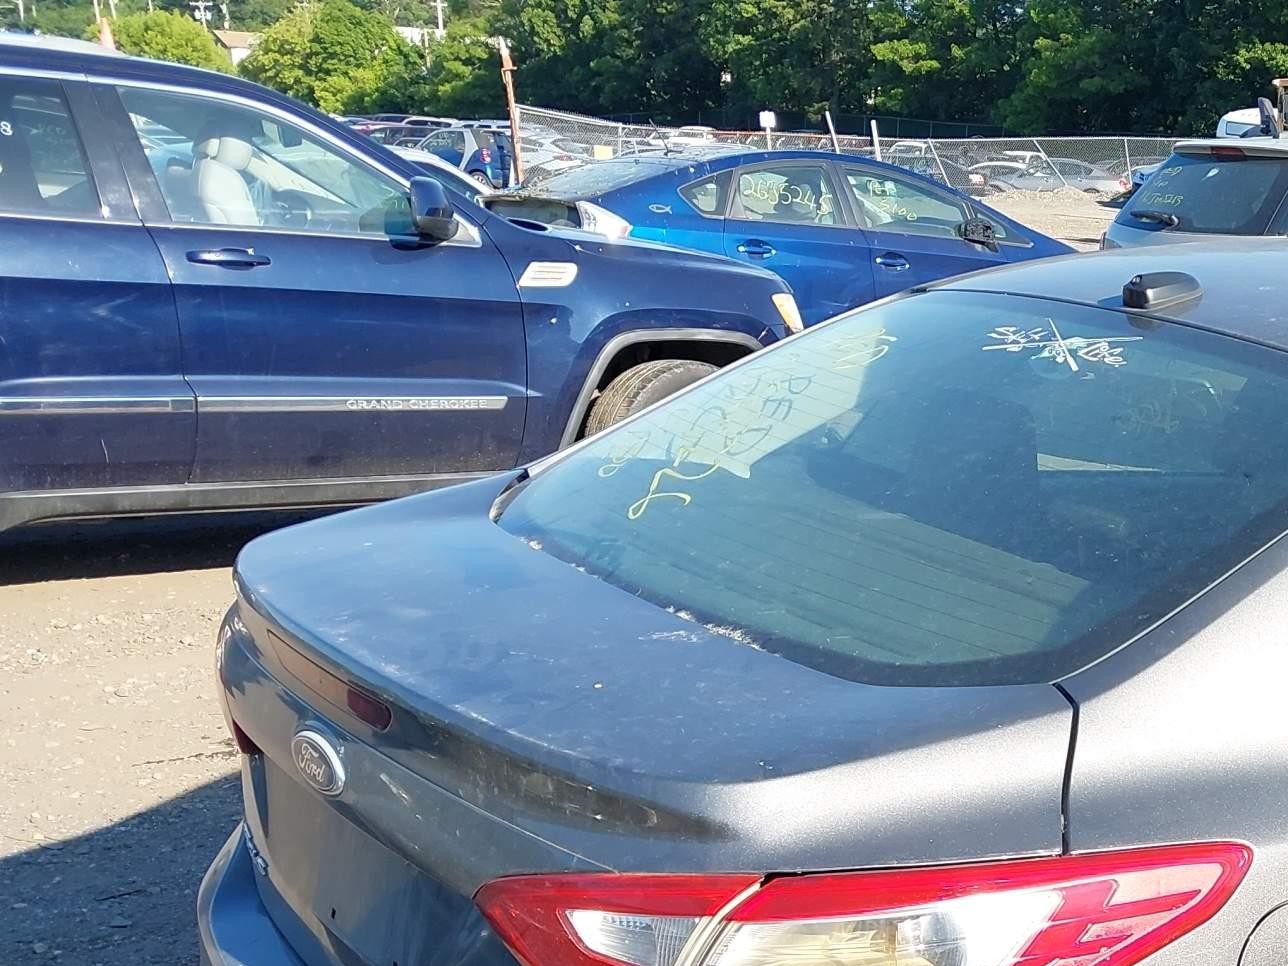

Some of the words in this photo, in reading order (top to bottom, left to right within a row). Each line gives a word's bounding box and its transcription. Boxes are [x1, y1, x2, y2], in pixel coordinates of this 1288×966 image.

[346, 400, 402, 409] GRAND
[408, 400, 488, 409] CHEROKEE
[298, 743, 326, 783] Ford
